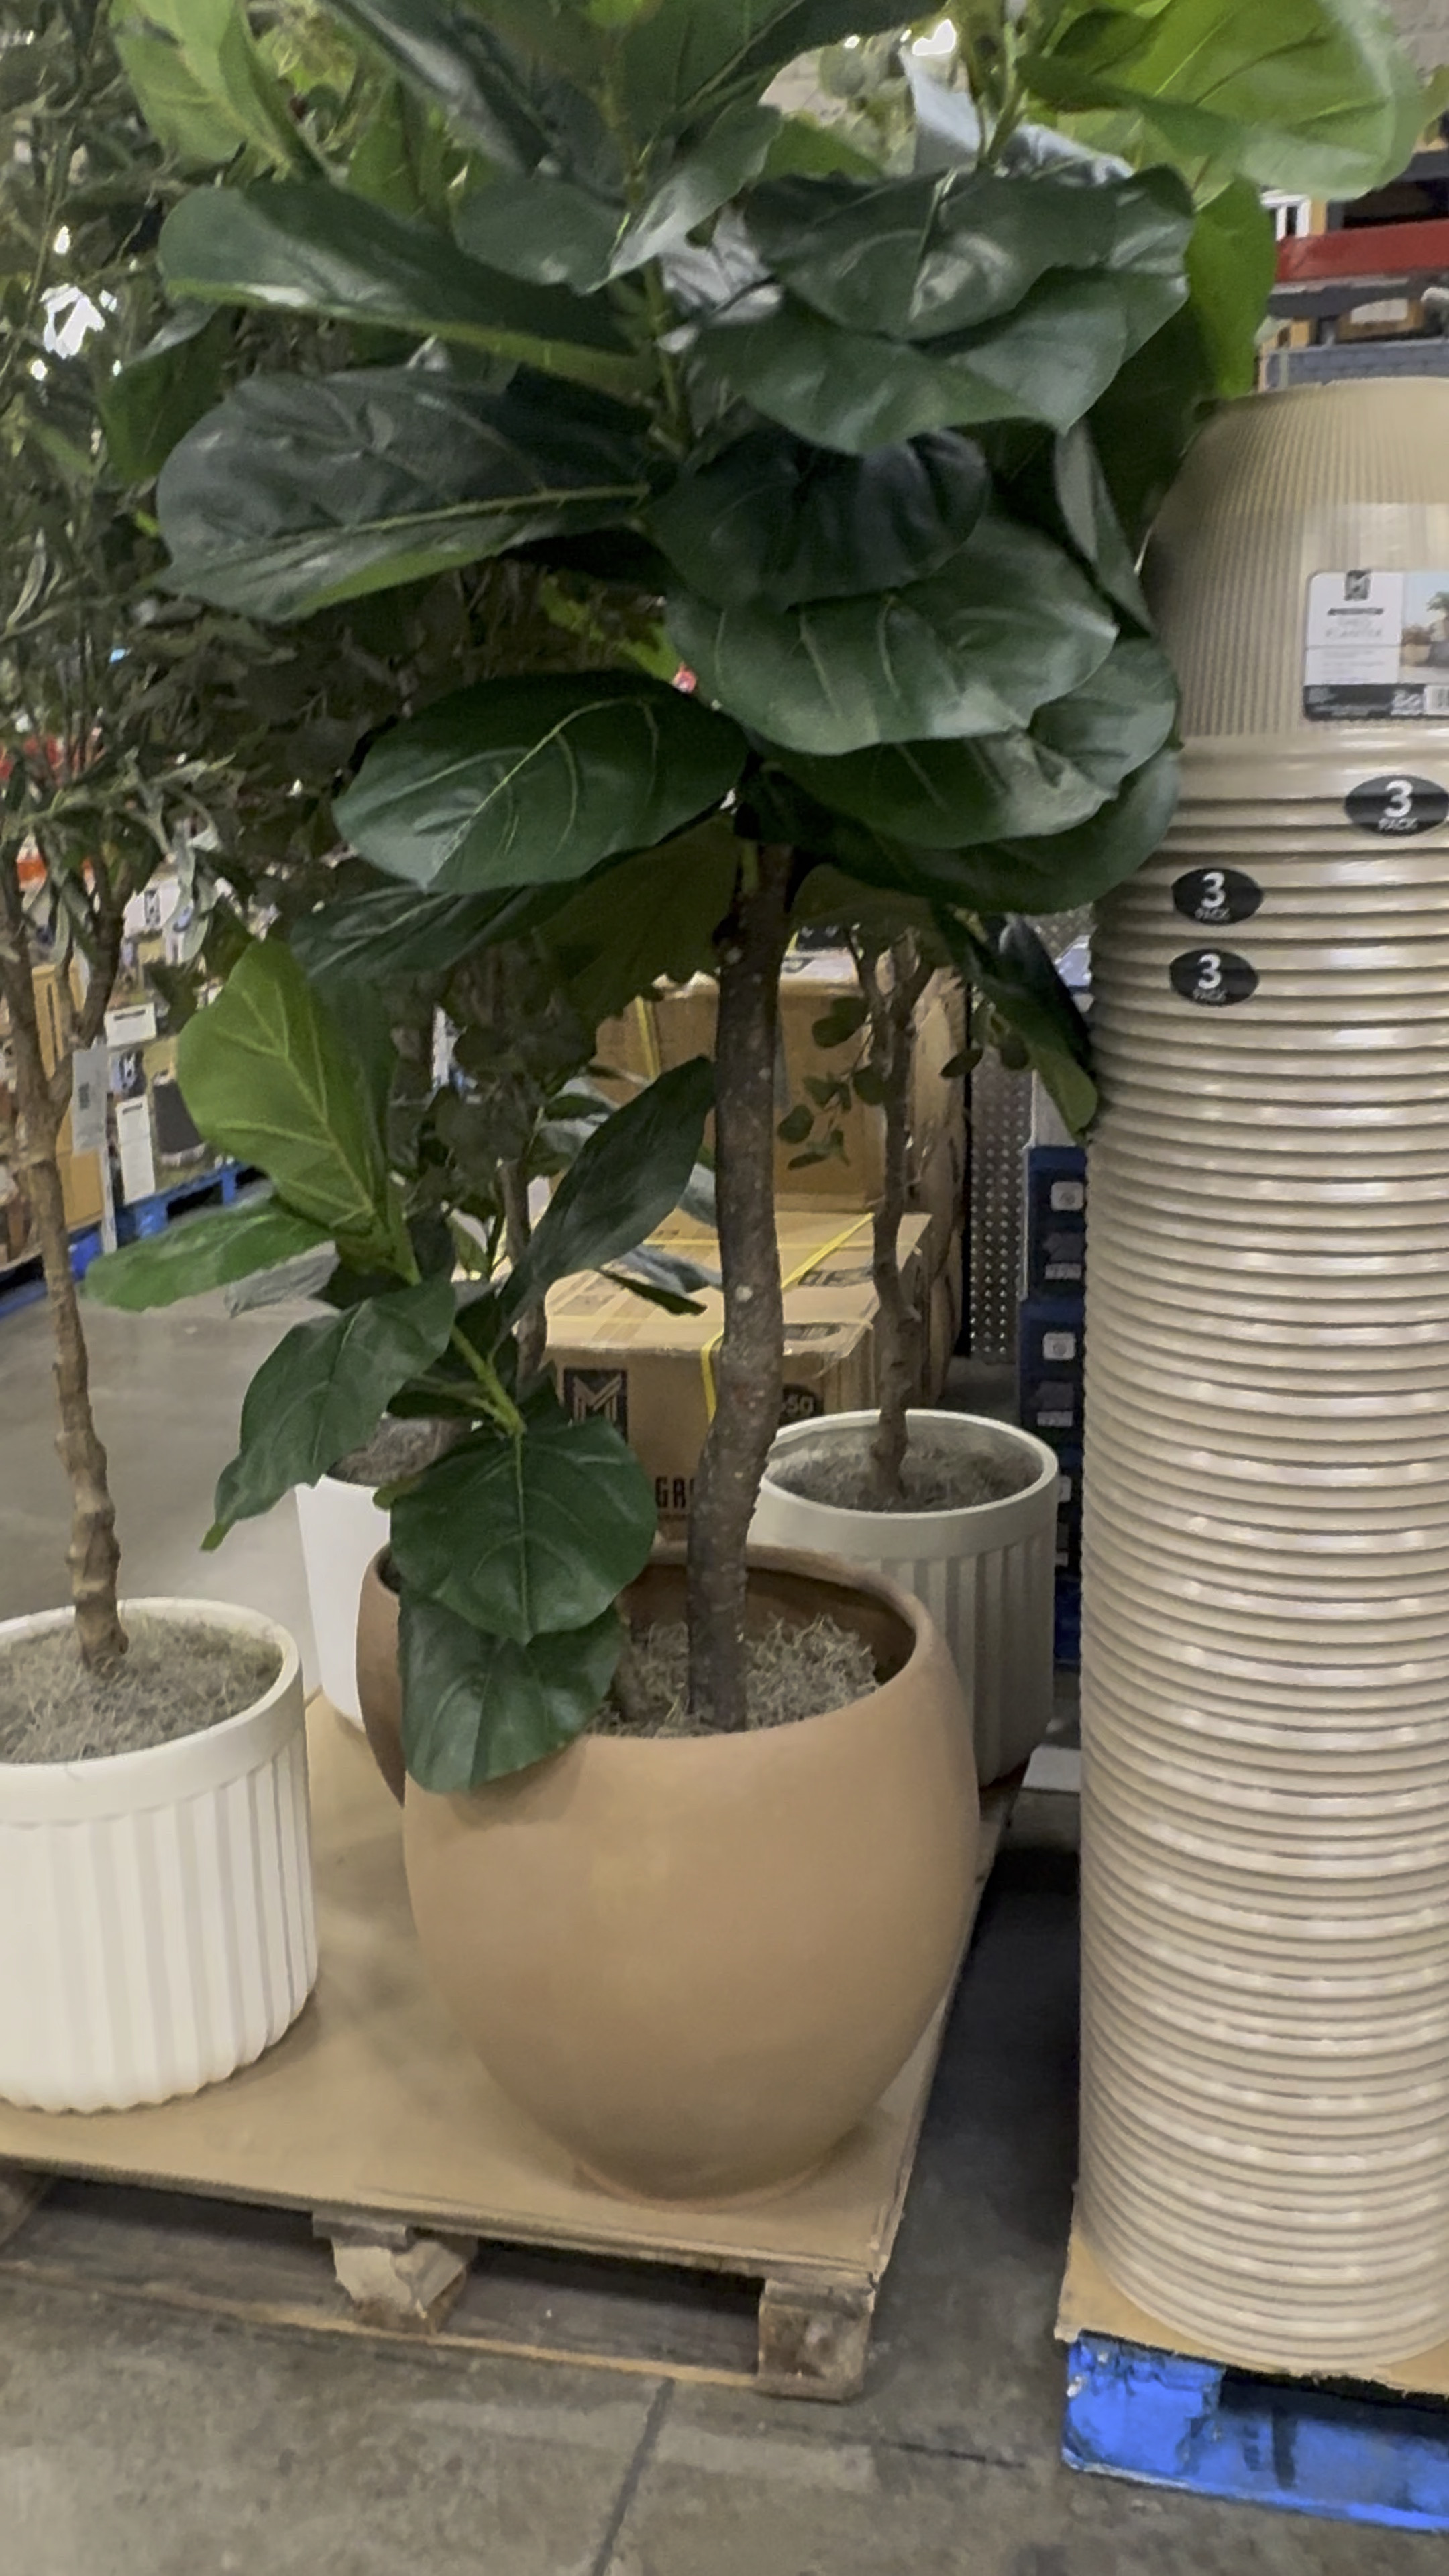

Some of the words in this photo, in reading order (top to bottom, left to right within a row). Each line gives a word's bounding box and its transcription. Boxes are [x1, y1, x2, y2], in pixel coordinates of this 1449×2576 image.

[1384, 780, 1413, 817] 3
[1201, 872, 1226, 908] 3
[1198, 953, 1221, 989] 3
